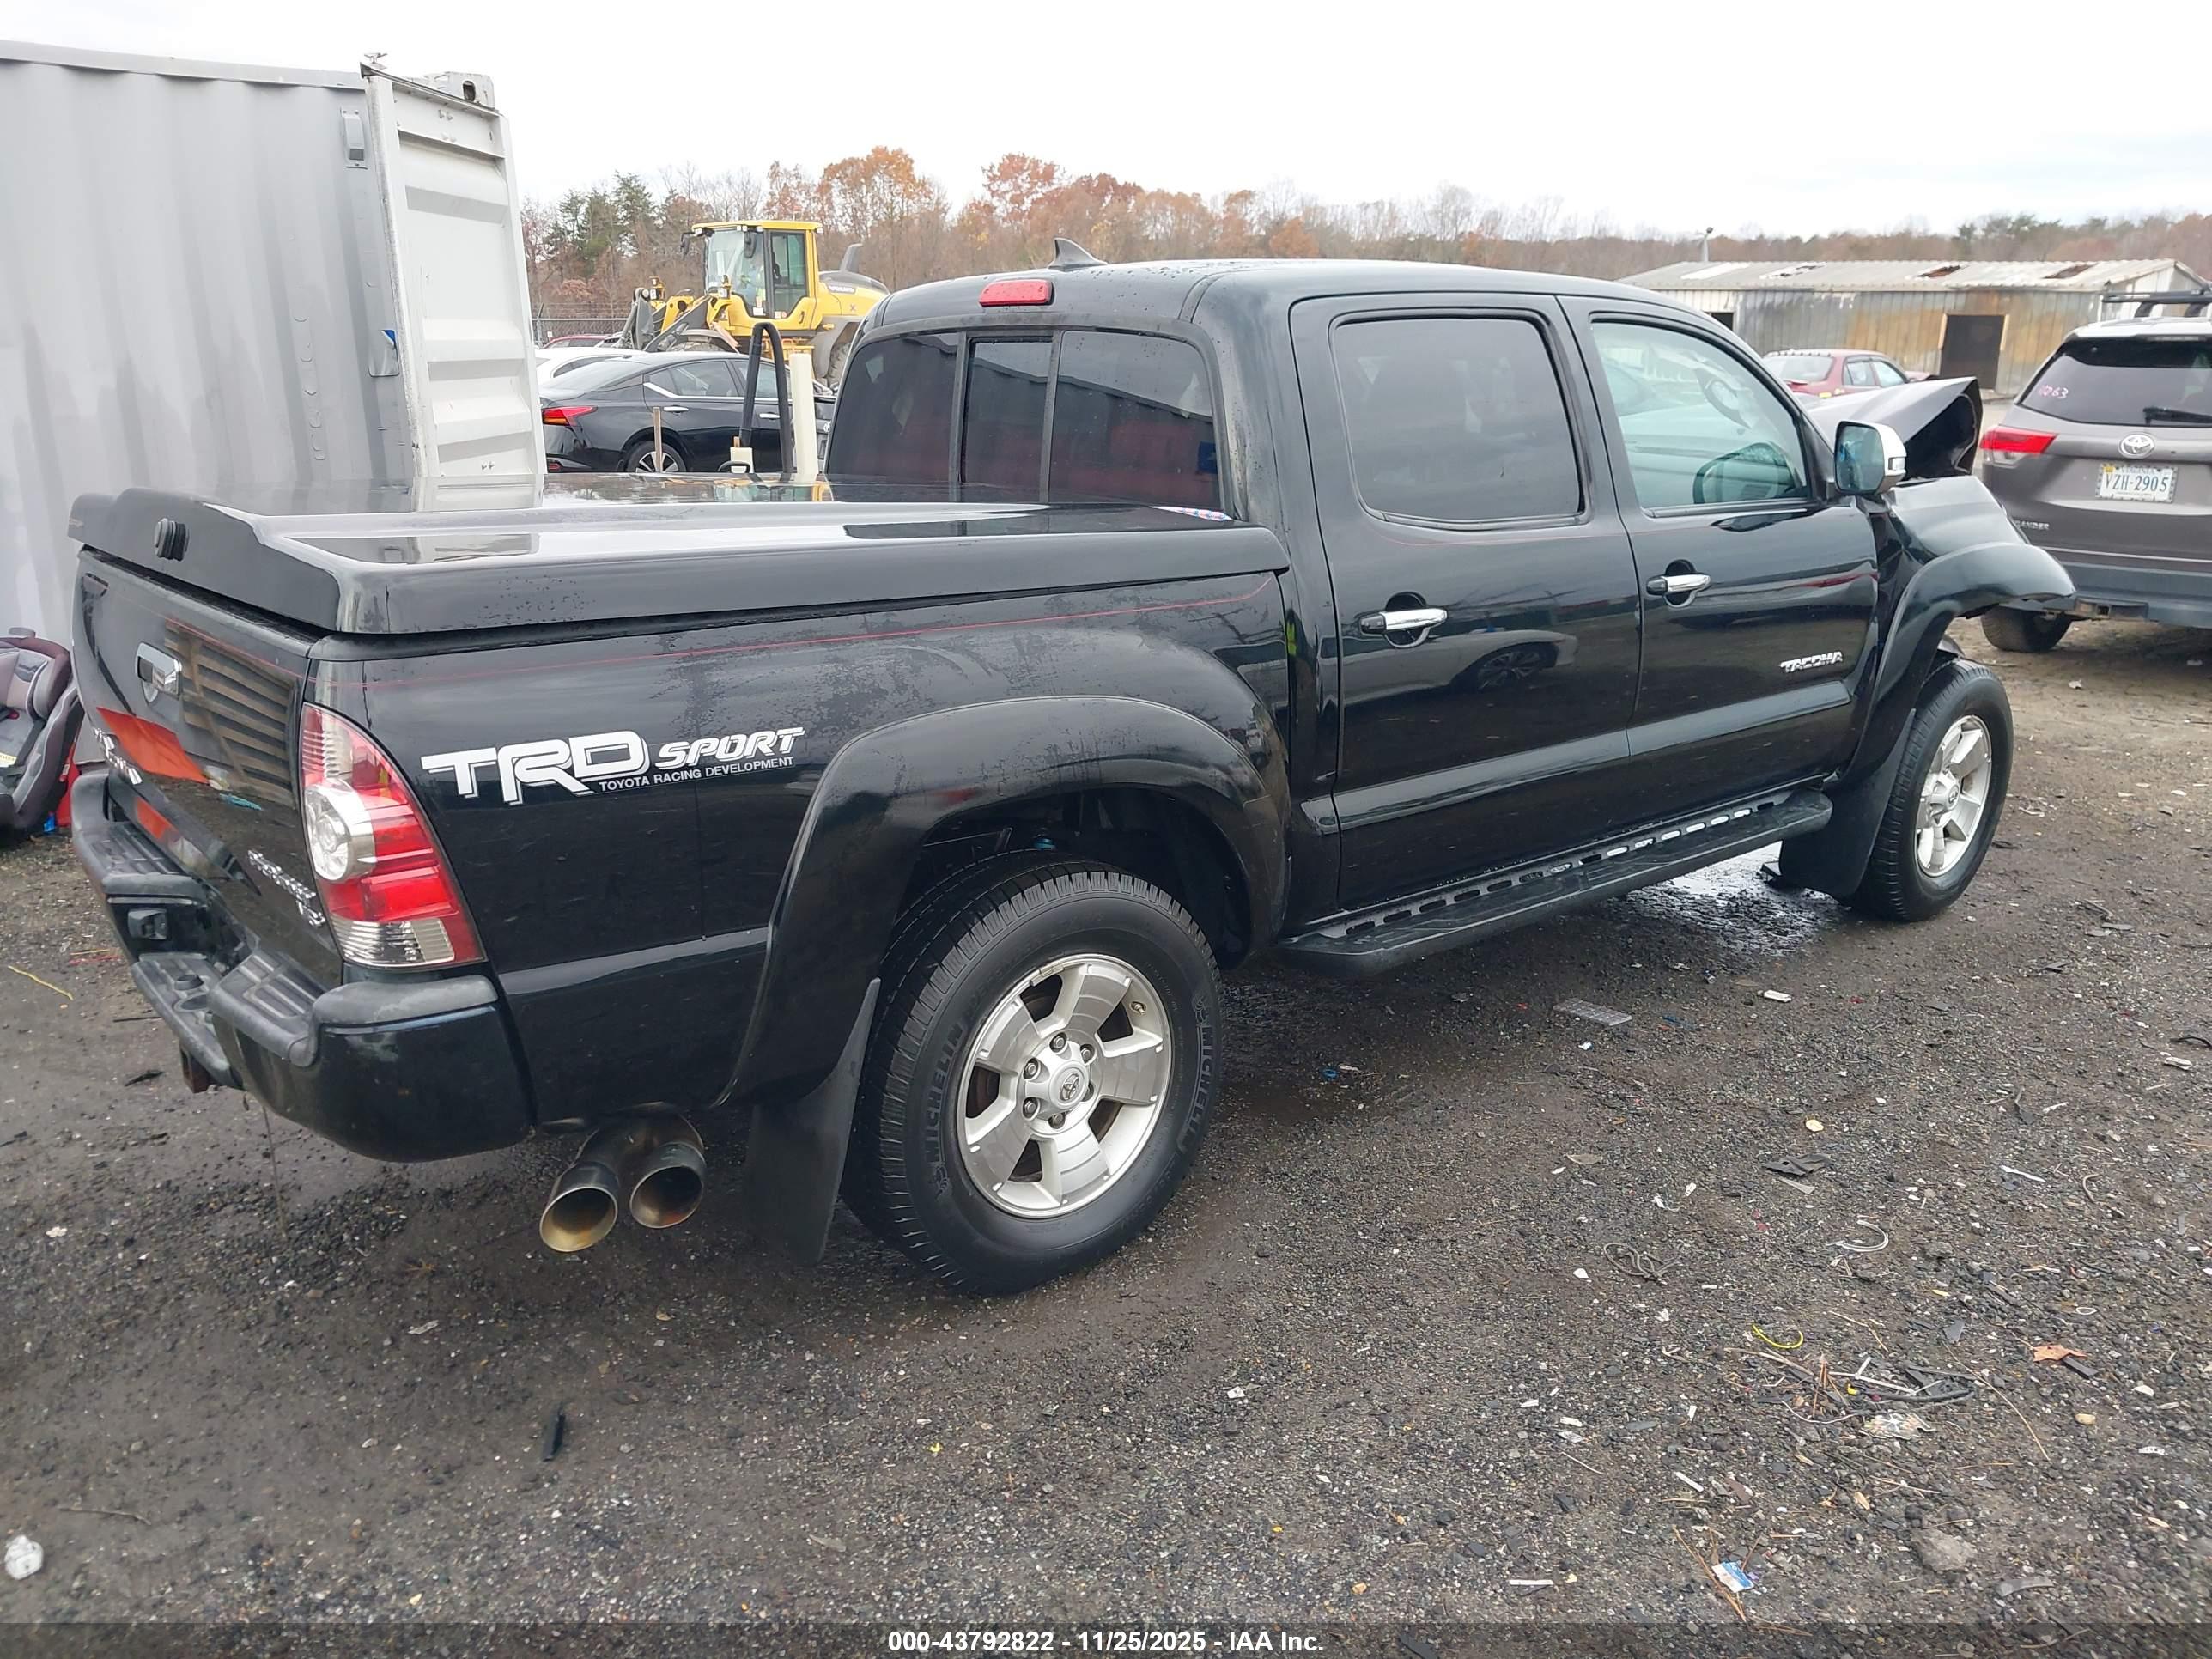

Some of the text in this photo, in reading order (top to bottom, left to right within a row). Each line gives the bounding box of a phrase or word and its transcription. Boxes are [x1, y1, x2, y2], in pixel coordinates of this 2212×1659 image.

[2105, 473, 2170, 493] VZH-2905
[1780, 651, 1844, 672] TACOMA
[421, 726, 805, 805] TRD SPORT
[599, 757, 794, 793] TOYOTA RACING DEVELOPMENT
[925, 1023, 964, 1163] MICHELIN
[1177, 1026, 1215, 1154] MICHELIN
